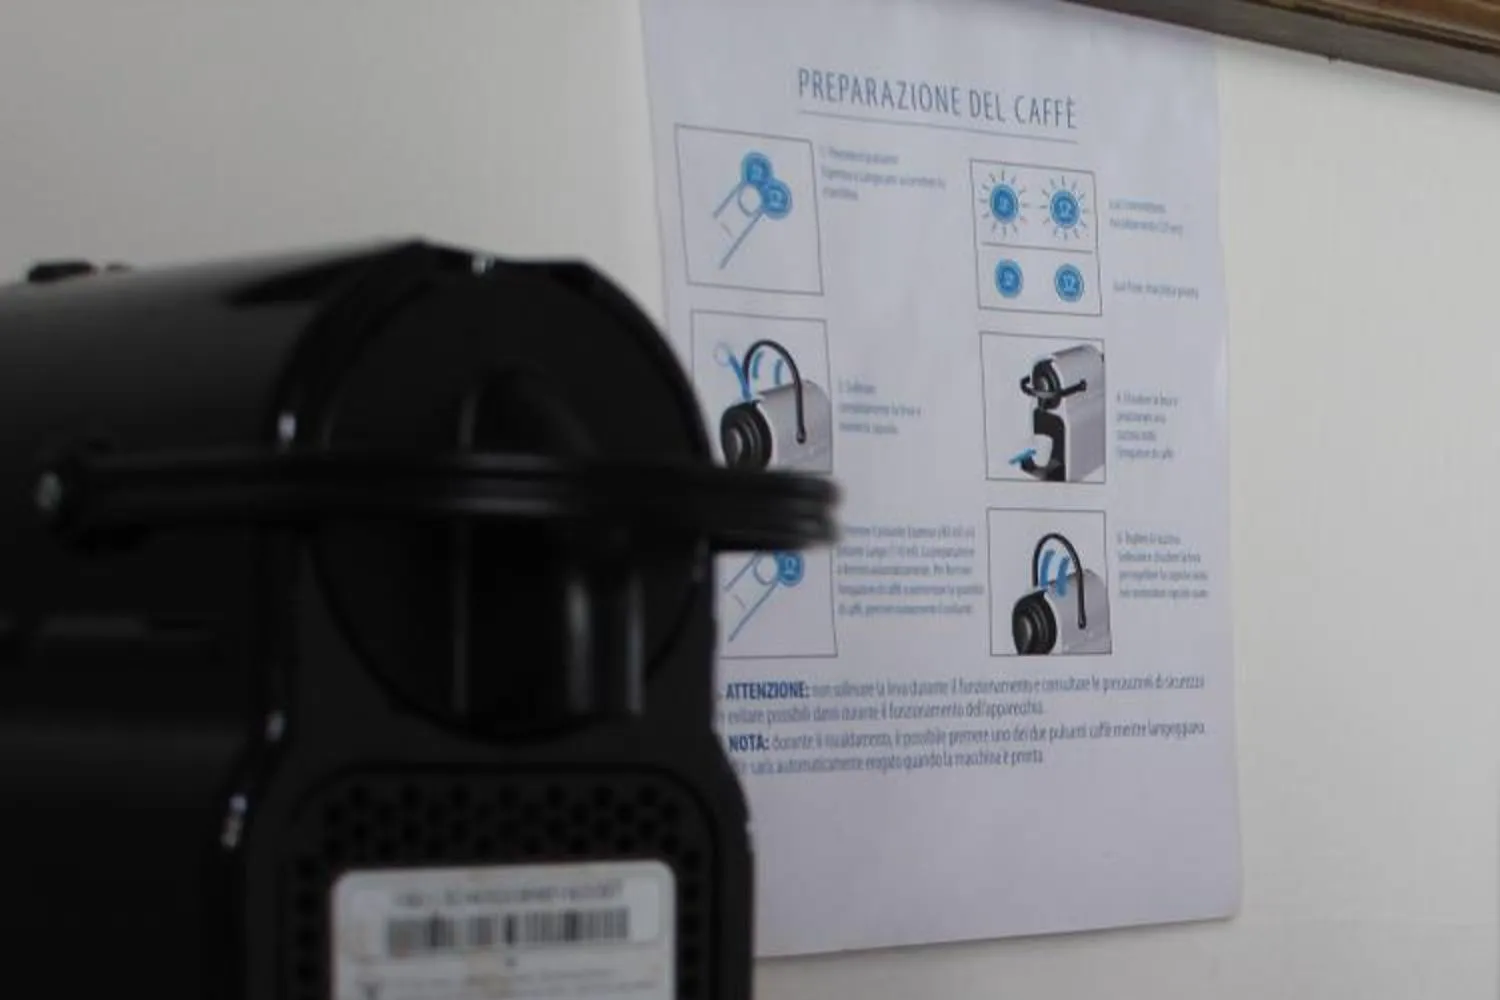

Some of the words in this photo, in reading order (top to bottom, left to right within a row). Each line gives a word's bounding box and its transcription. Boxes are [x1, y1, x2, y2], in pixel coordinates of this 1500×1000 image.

[798, 67, 961, 116] PREPARAZIONE
[969, 89, 1006, 123] DEL
[1014, 95, 1078, 129] CAFFÈ
[725, 680, 810, 700] ATTENZIONE:
[728, 734, 769, 752] NOTA:
